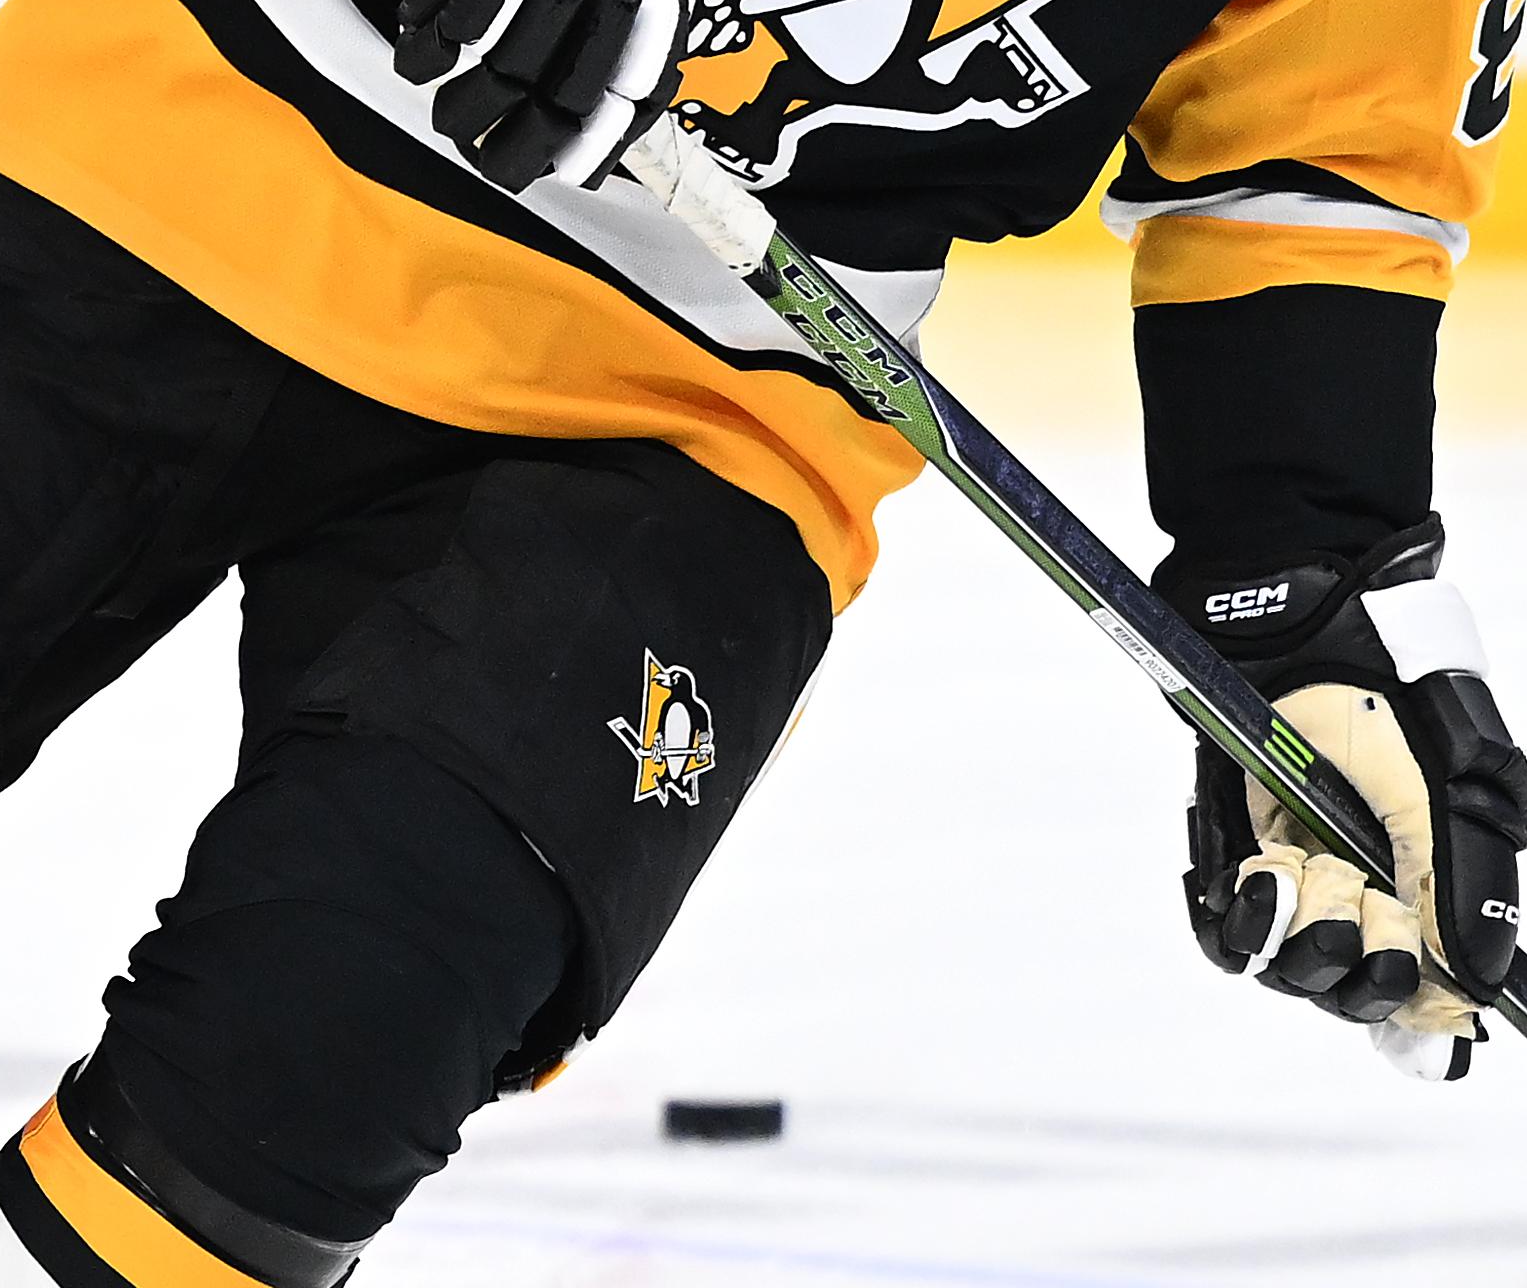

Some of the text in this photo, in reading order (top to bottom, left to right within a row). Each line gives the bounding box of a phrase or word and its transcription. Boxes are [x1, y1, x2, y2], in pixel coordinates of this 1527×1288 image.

[779, 254, 913, 387] CCM
[782, 307, 913, 421] CCM
[1205, 582, 1290, 614] CCM
[1229, 607, 1265, 621] PRO
